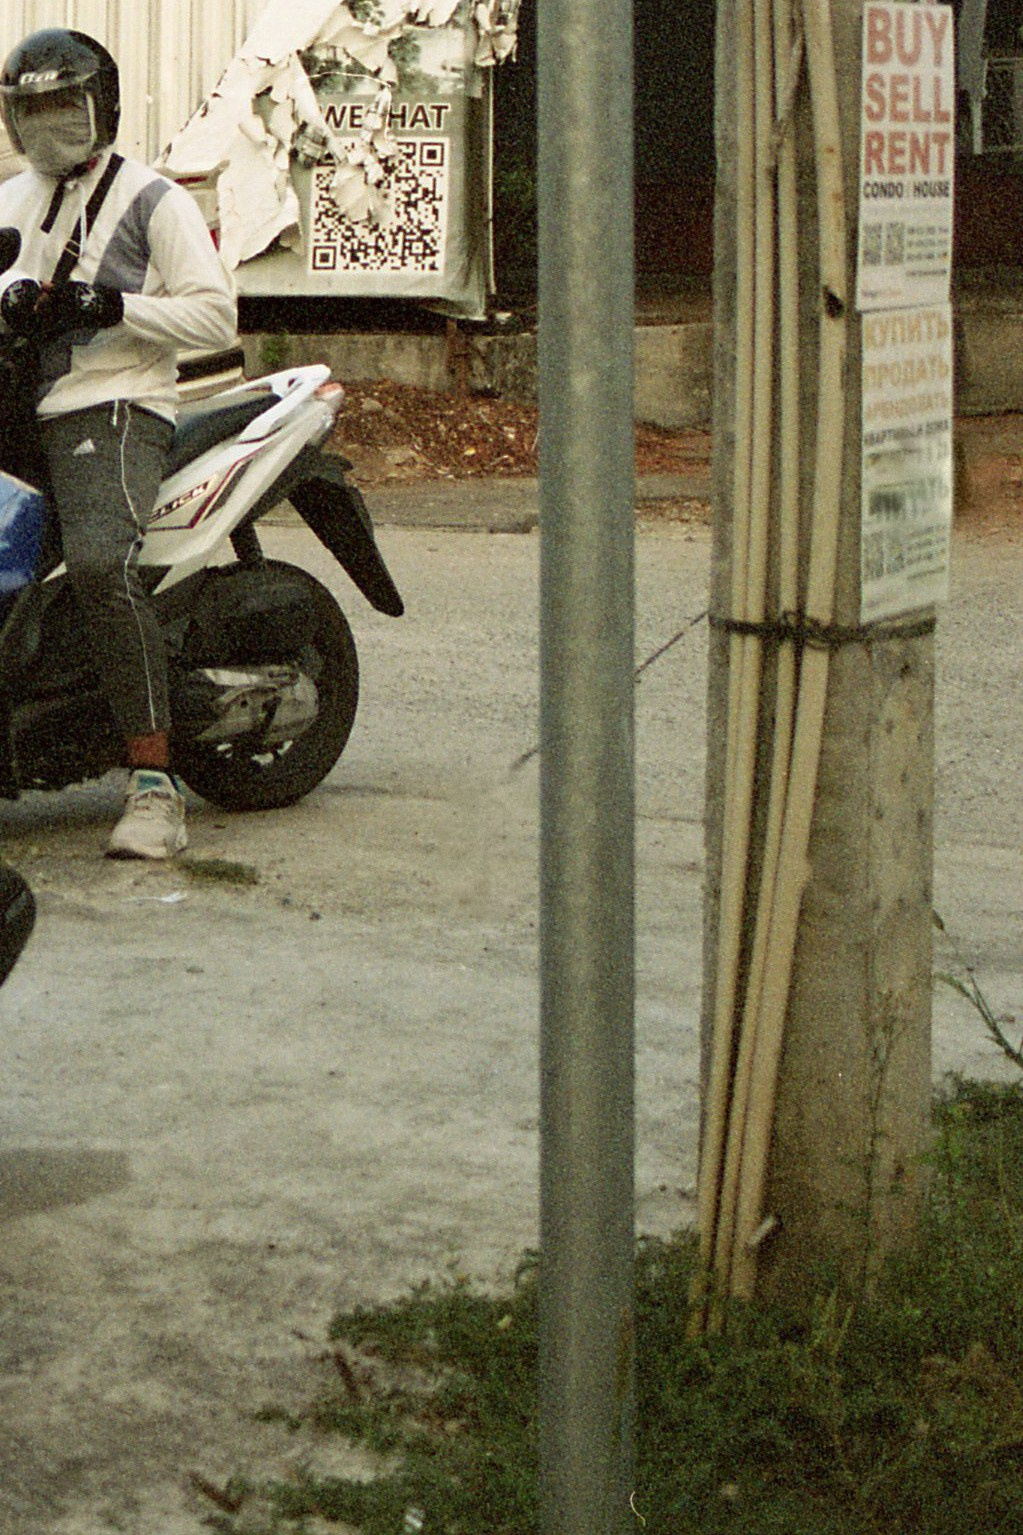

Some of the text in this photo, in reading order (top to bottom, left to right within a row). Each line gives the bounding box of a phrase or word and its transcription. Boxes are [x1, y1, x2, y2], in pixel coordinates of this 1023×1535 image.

[866, 8, 948, 66] BUY
[325, 104, 449, 129] WEHAT
[864, 72, 950, 123] SELL
[863, 129, 950, 177] RENT
